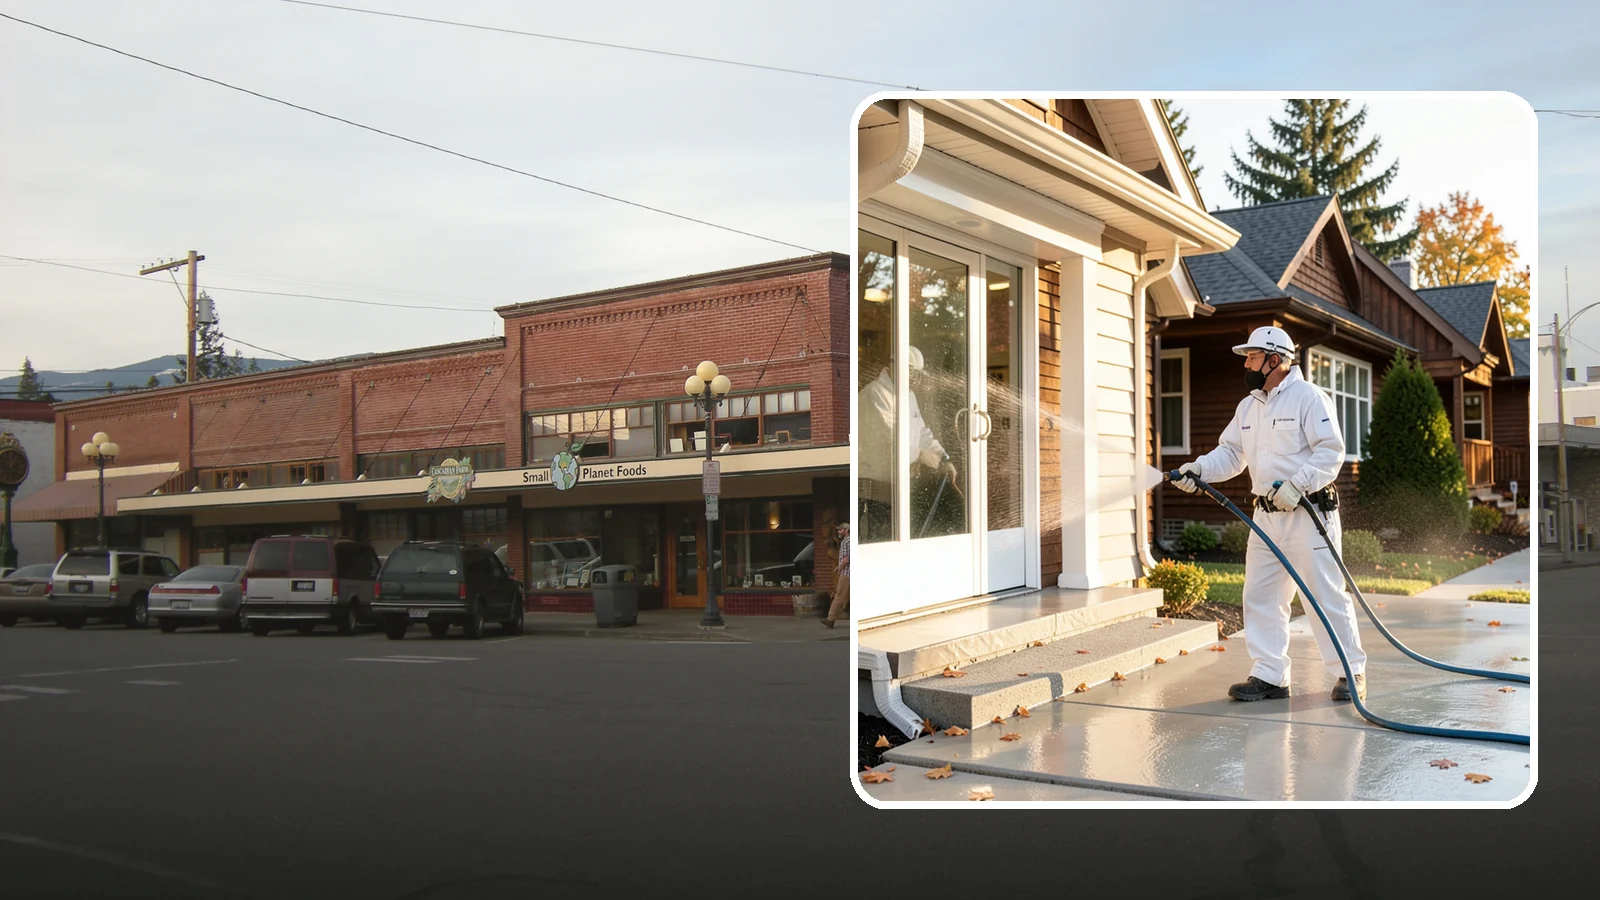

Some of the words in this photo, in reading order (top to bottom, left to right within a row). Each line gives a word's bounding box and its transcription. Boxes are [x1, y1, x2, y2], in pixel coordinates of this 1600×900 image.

[523, 471, 549, 483] Small
[583, 468, 614, 479] Planet
[617, 464, 647, 477] Foods
